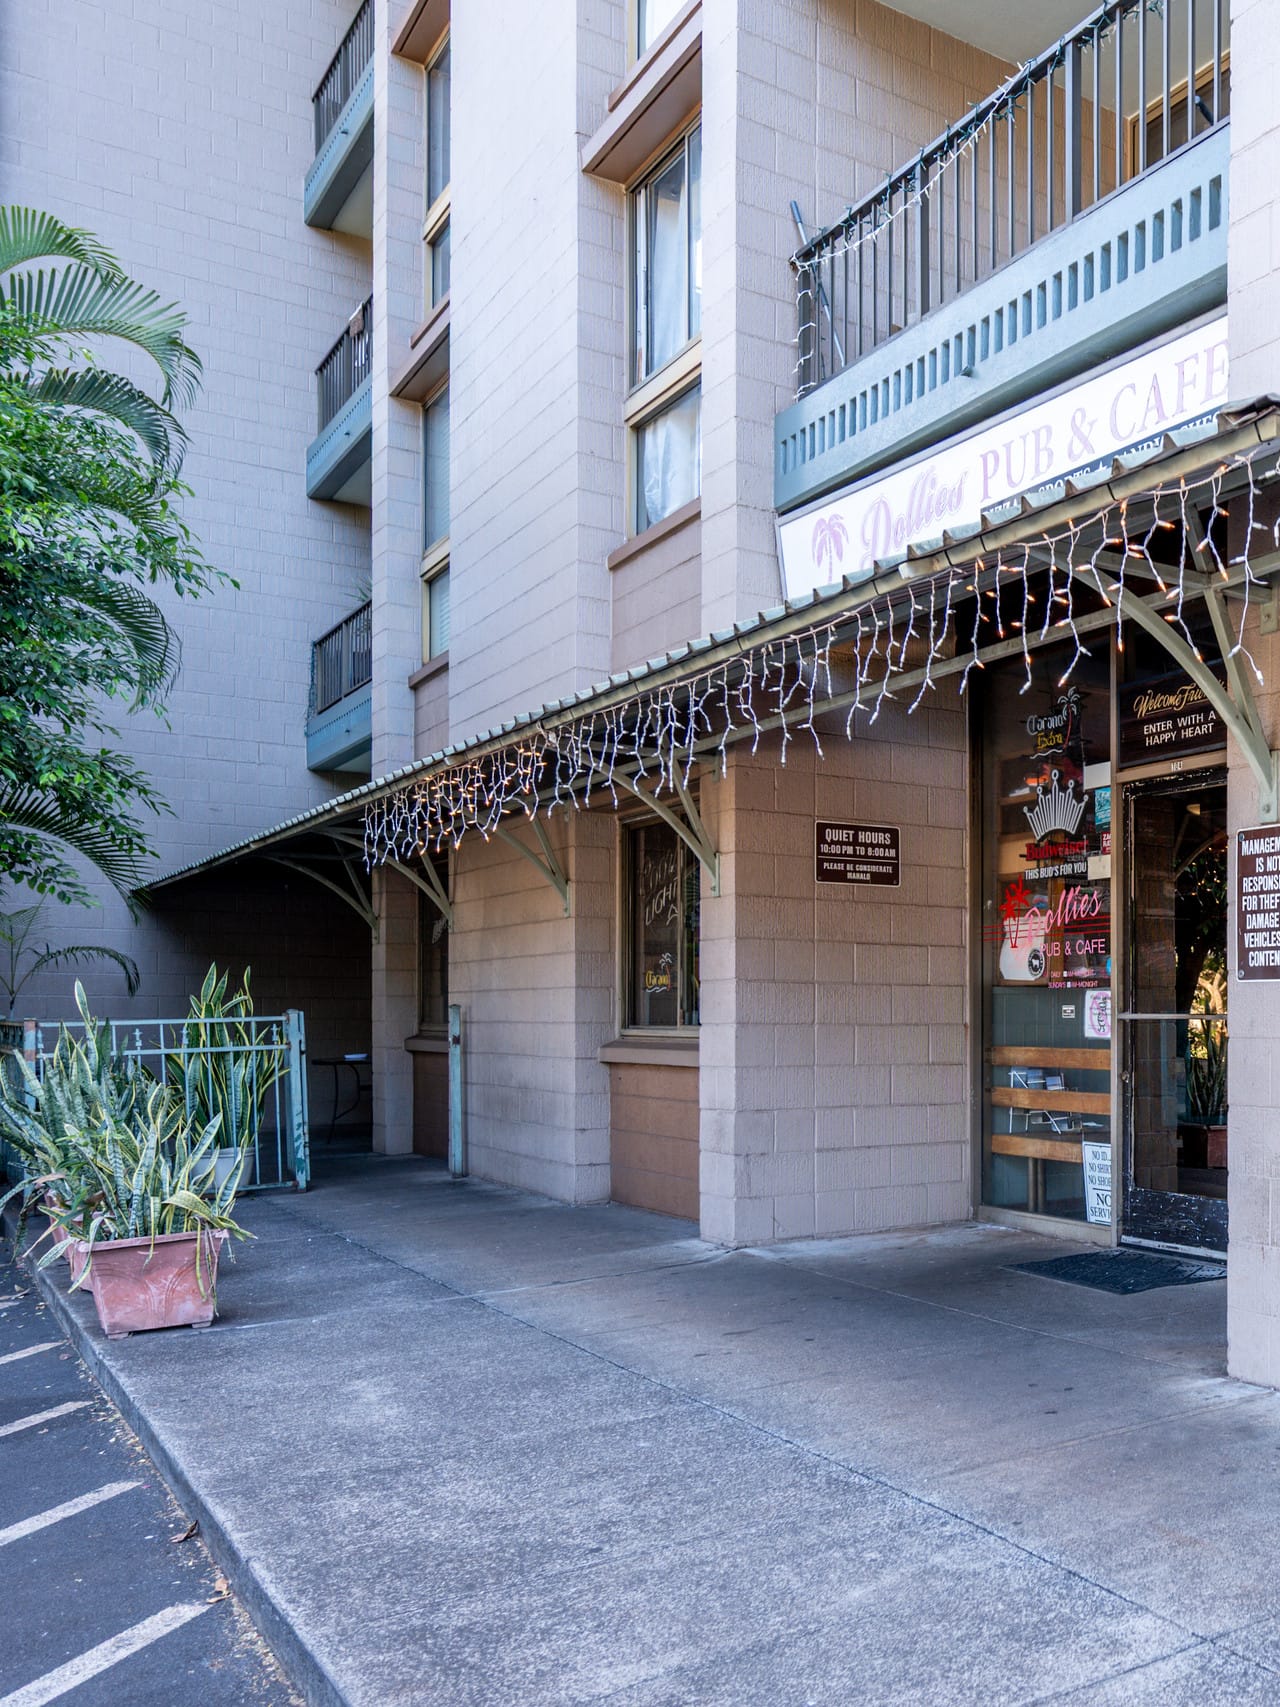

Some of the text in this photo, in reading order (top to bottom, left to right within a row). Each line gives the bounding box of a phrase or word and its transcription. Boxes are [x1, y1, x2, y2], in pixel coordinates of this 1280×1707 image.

[979, 428, 1055, 502] PUB
[1068, 407, 1097, 462] &
[1109, 340, 1228, 441] CAFE
[859, 466, 969, 570] Dollies
[1133, 689, 1181, 719] Welcome
[1143, 710, 1216, 735] ENTER WITH A
[1145, 723, 1214, 746] HAPPY HEART
[825, 828, 891, 845] QUIET HOURS
[820, 844, 896, 857] 10:00 PM TO 8:00 AM
[1025, 840, 1089, 861] Budweiser
[823, 862, 844, 870] PLEASE
[855, 865, 893, 873] CONSIDERATE
[1025, 861, 1087, 880] THIS BUD'S FOR YOU
[1255, 857, 1264, 872] IS
[1242, 895, 1257, 911] FOR
[1246, 912, 1279, 929] DAMAGE
[1039, 938, 1106, 957] PUB & CAFE
[1244, 932, 1280, 948] VEHICLES
[1092, 1151, 1100, 1160] NO
[1089, 1163, 1097, 1172] NO
[1088, 1175, 1097, 1185] NO
[1096, 1193, 1112, 1207] NO
[1090, 1206, 1112, 1218] SERVI
